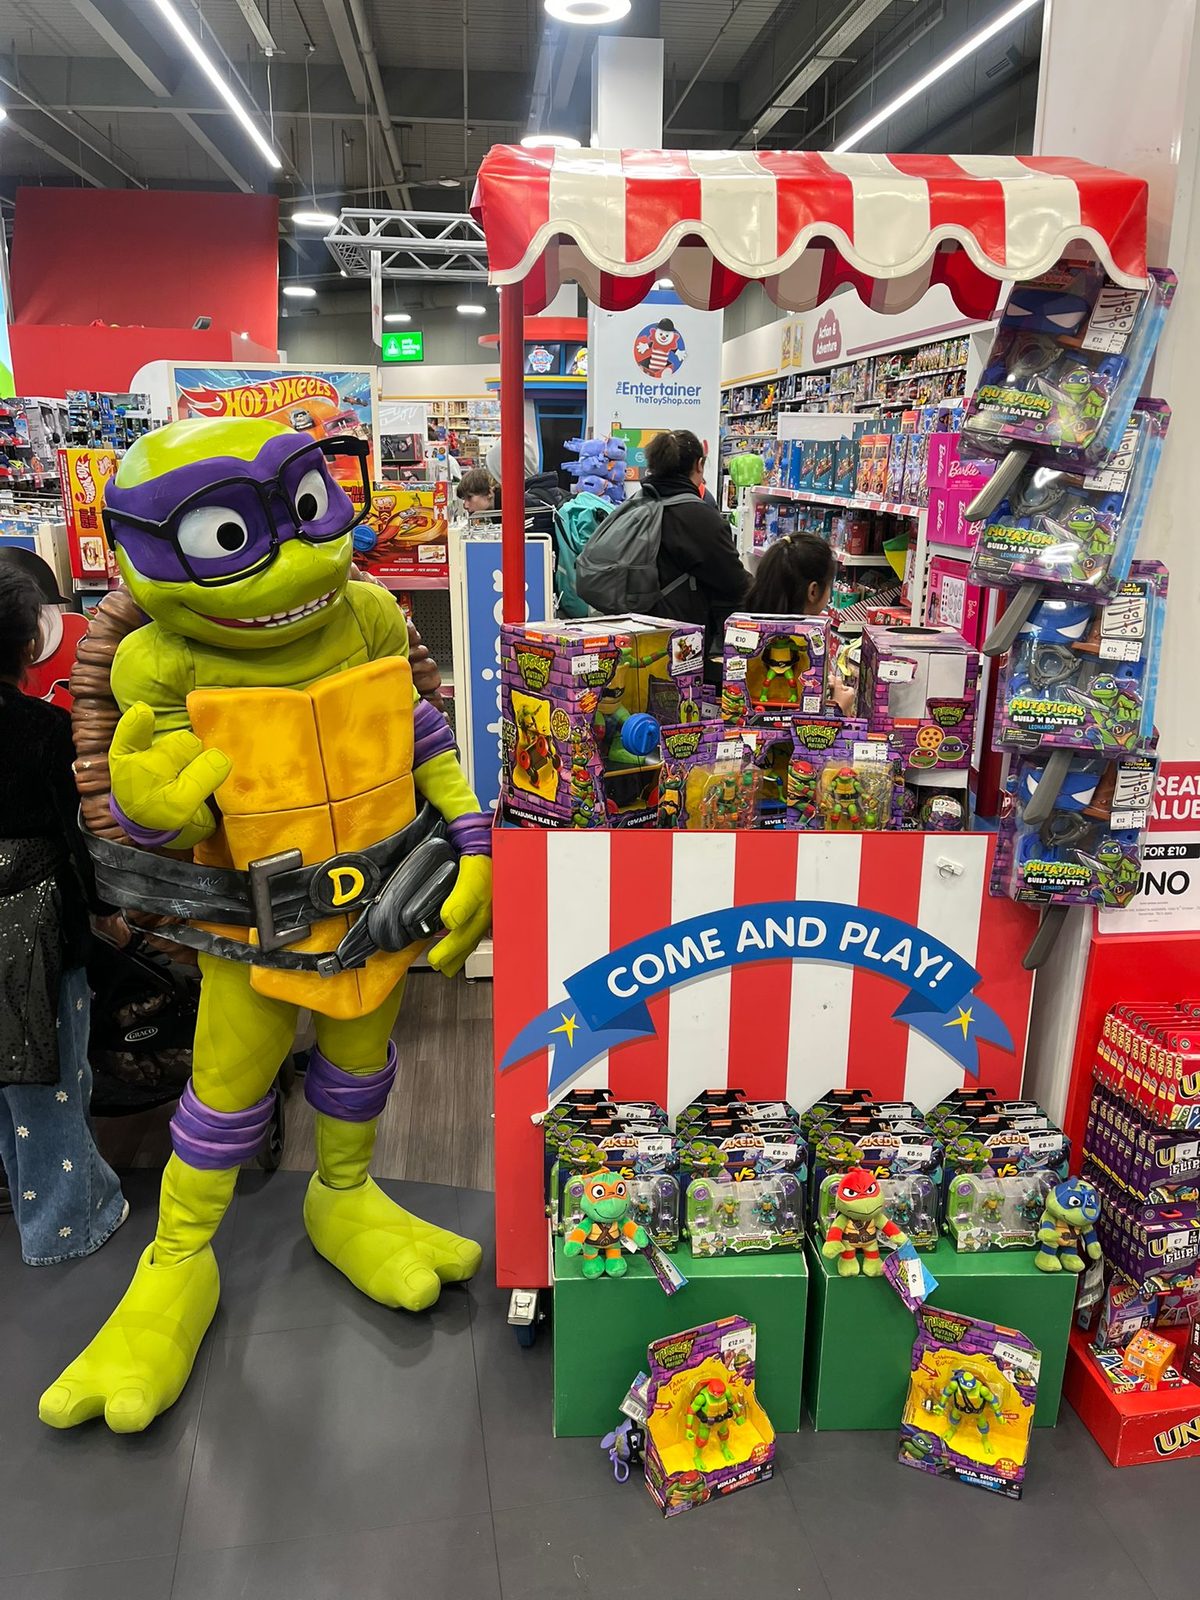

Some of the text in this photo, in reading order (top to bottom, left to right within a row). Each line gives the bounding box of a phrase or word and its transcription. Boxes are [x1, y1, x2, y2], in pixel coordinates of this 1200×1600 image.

[622, 382, 702, 397] Entertainer
[219, 389, 261, 416] HOT
[635, 396, 701, 406] TheToyShop.com
[981, 386, 1051, 410] MUTATIONS
[979, 402, 1000, 411] BUILD
[1009, 407, 1043, 419] BATTLE
[948, 460, 980, 478] Barbie
[986, 542, 1008, 551] BUILD
[1012, 699, 1084, 716] MUTATIONS
[1045, 716, 1078, 725] BATTLE
[1155, 775, 1200, 796] REAT
[1149, 800, 1200, 820] ALUE
[627, 812, 658, 826] COWABUN
[1144, 846, 1187, 857] FOR £10
[1027, 862, 1091, 877] MUTATIONS
[327, 867, 366, 906] D
[606, 915, 954, 999] COME AND PLAY!
[129, 1028, 155, 1040] GRACO
[723, 1137, 765, 1150] AKEDO
[860, 1136, 900, 1147] AKEDO
[989, 1134, 1030, 1145] AKEDO
[734, 1166, 756, 1182] VS
[997, 1163, 1018, 1178] VS
[1165, 1245, 1198, 1264] FLIP!
[1112, 1286, 1136, 1307] UNO
[1114, 1383, 1136, 1394] UNO
[1155, 1416, 1200, 1456] UN
[717, 1466, 761, 1489] NINJA SHOUTS
[955, 1467, 1007, 1485] NINJA SHOUTS
